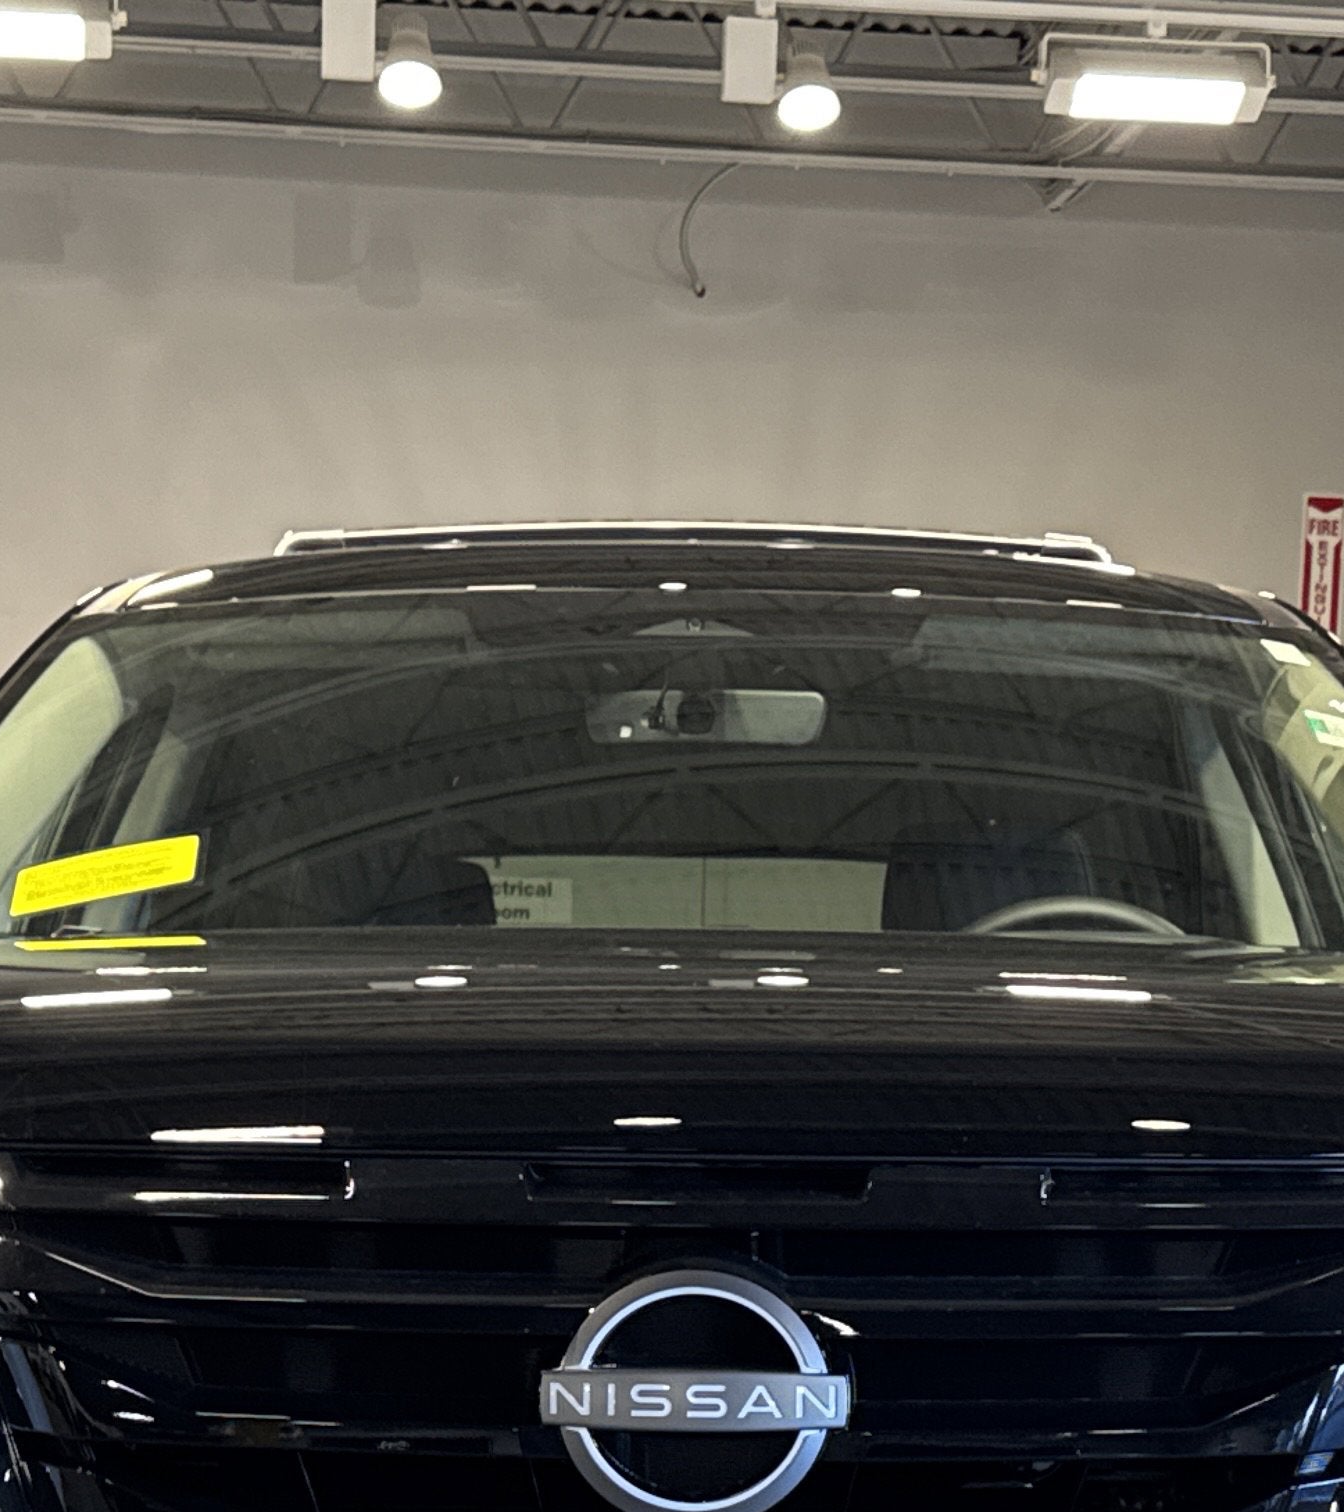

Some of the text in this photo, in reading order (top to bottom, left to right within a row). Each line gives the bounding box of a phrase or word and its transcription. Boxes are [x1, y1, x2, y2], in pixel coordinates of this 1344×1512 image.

[1308, 519, 1340, 537] FIRE
[1313, 540, 1329, 624] EXTINGUI
[492, 881, 552, 897] ctrical
[548, 1382, 837, 1420] NISSAN
